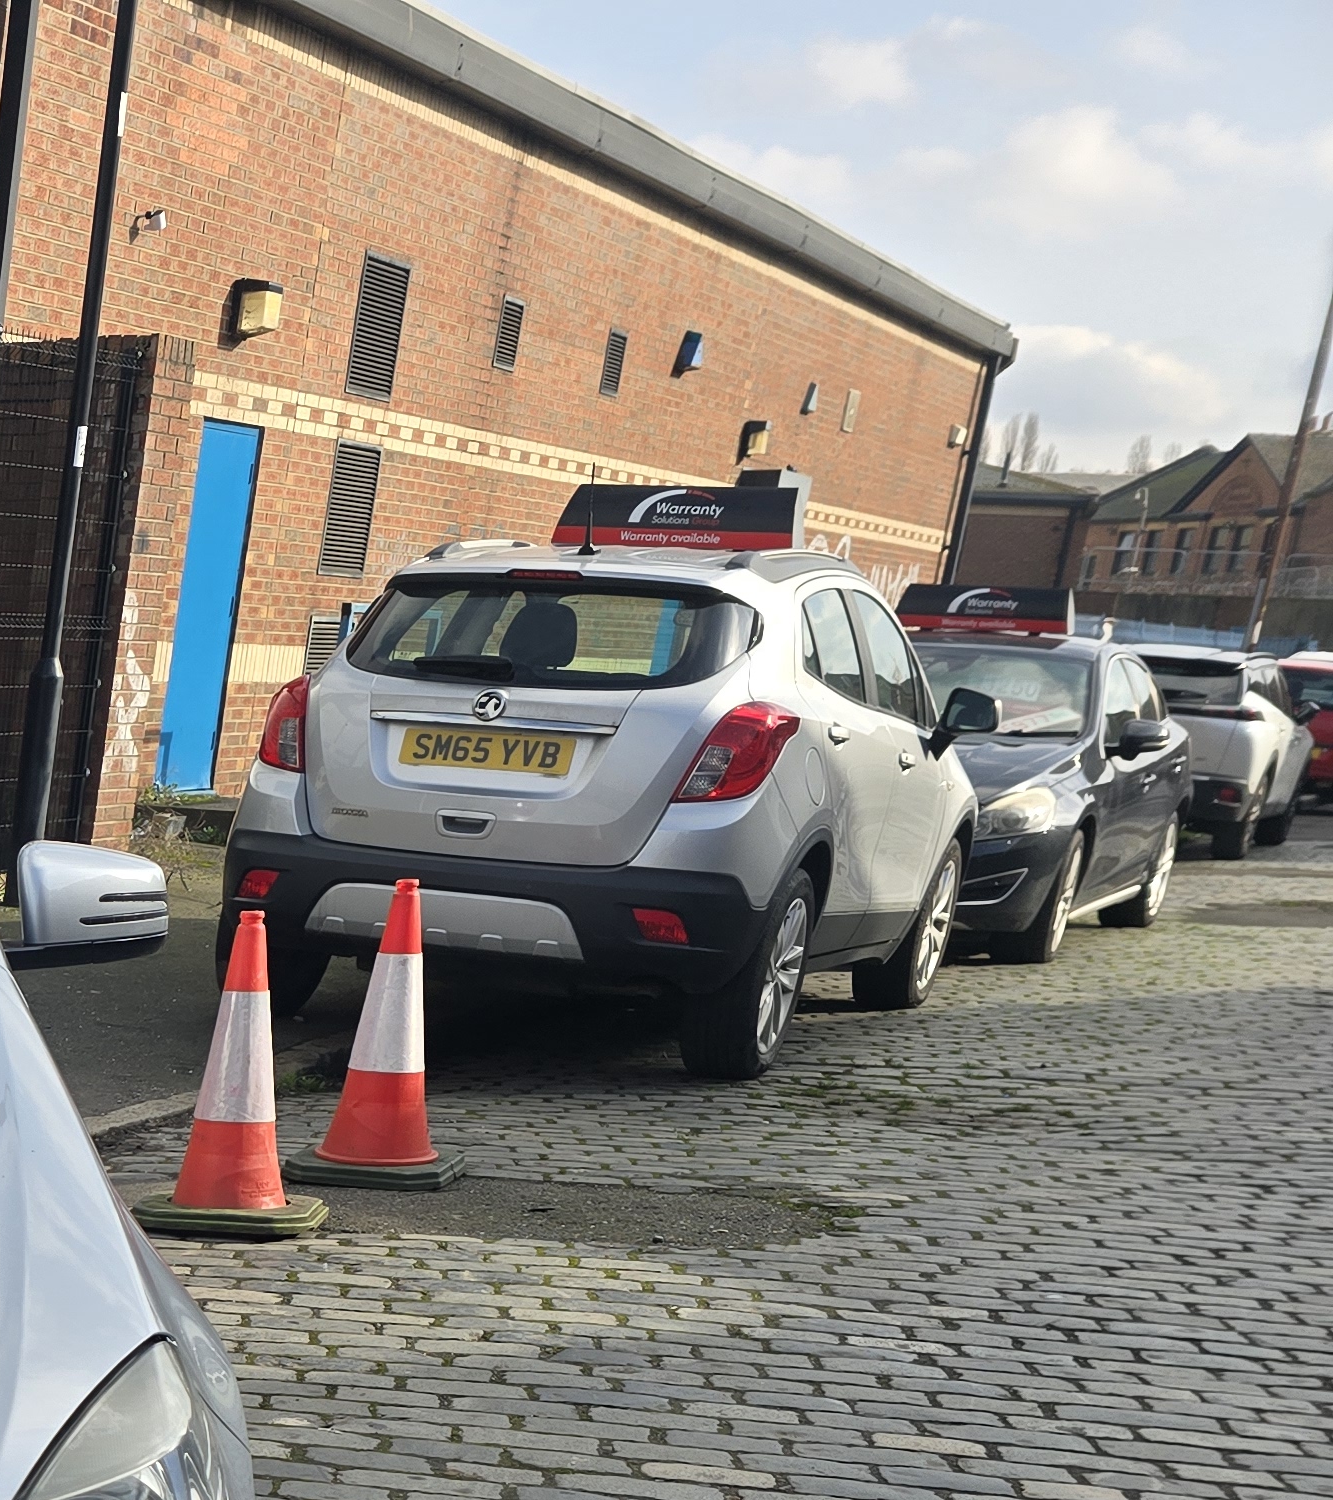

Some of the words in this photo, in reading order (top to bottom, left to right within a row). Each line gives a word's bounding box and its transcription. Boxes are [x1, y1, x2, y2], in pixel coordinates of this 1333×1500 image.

[656, 502, 725, 519] Warranty
[651, 515, 690, 526] Solutions
[620, 530, 669, 544] Warranty
[670, 532, 721, 544] available
[967, 597, 1019, 611] Warranty
[413, 733, 493, 764] SM65
[502, 739, 562, 768] YVB
